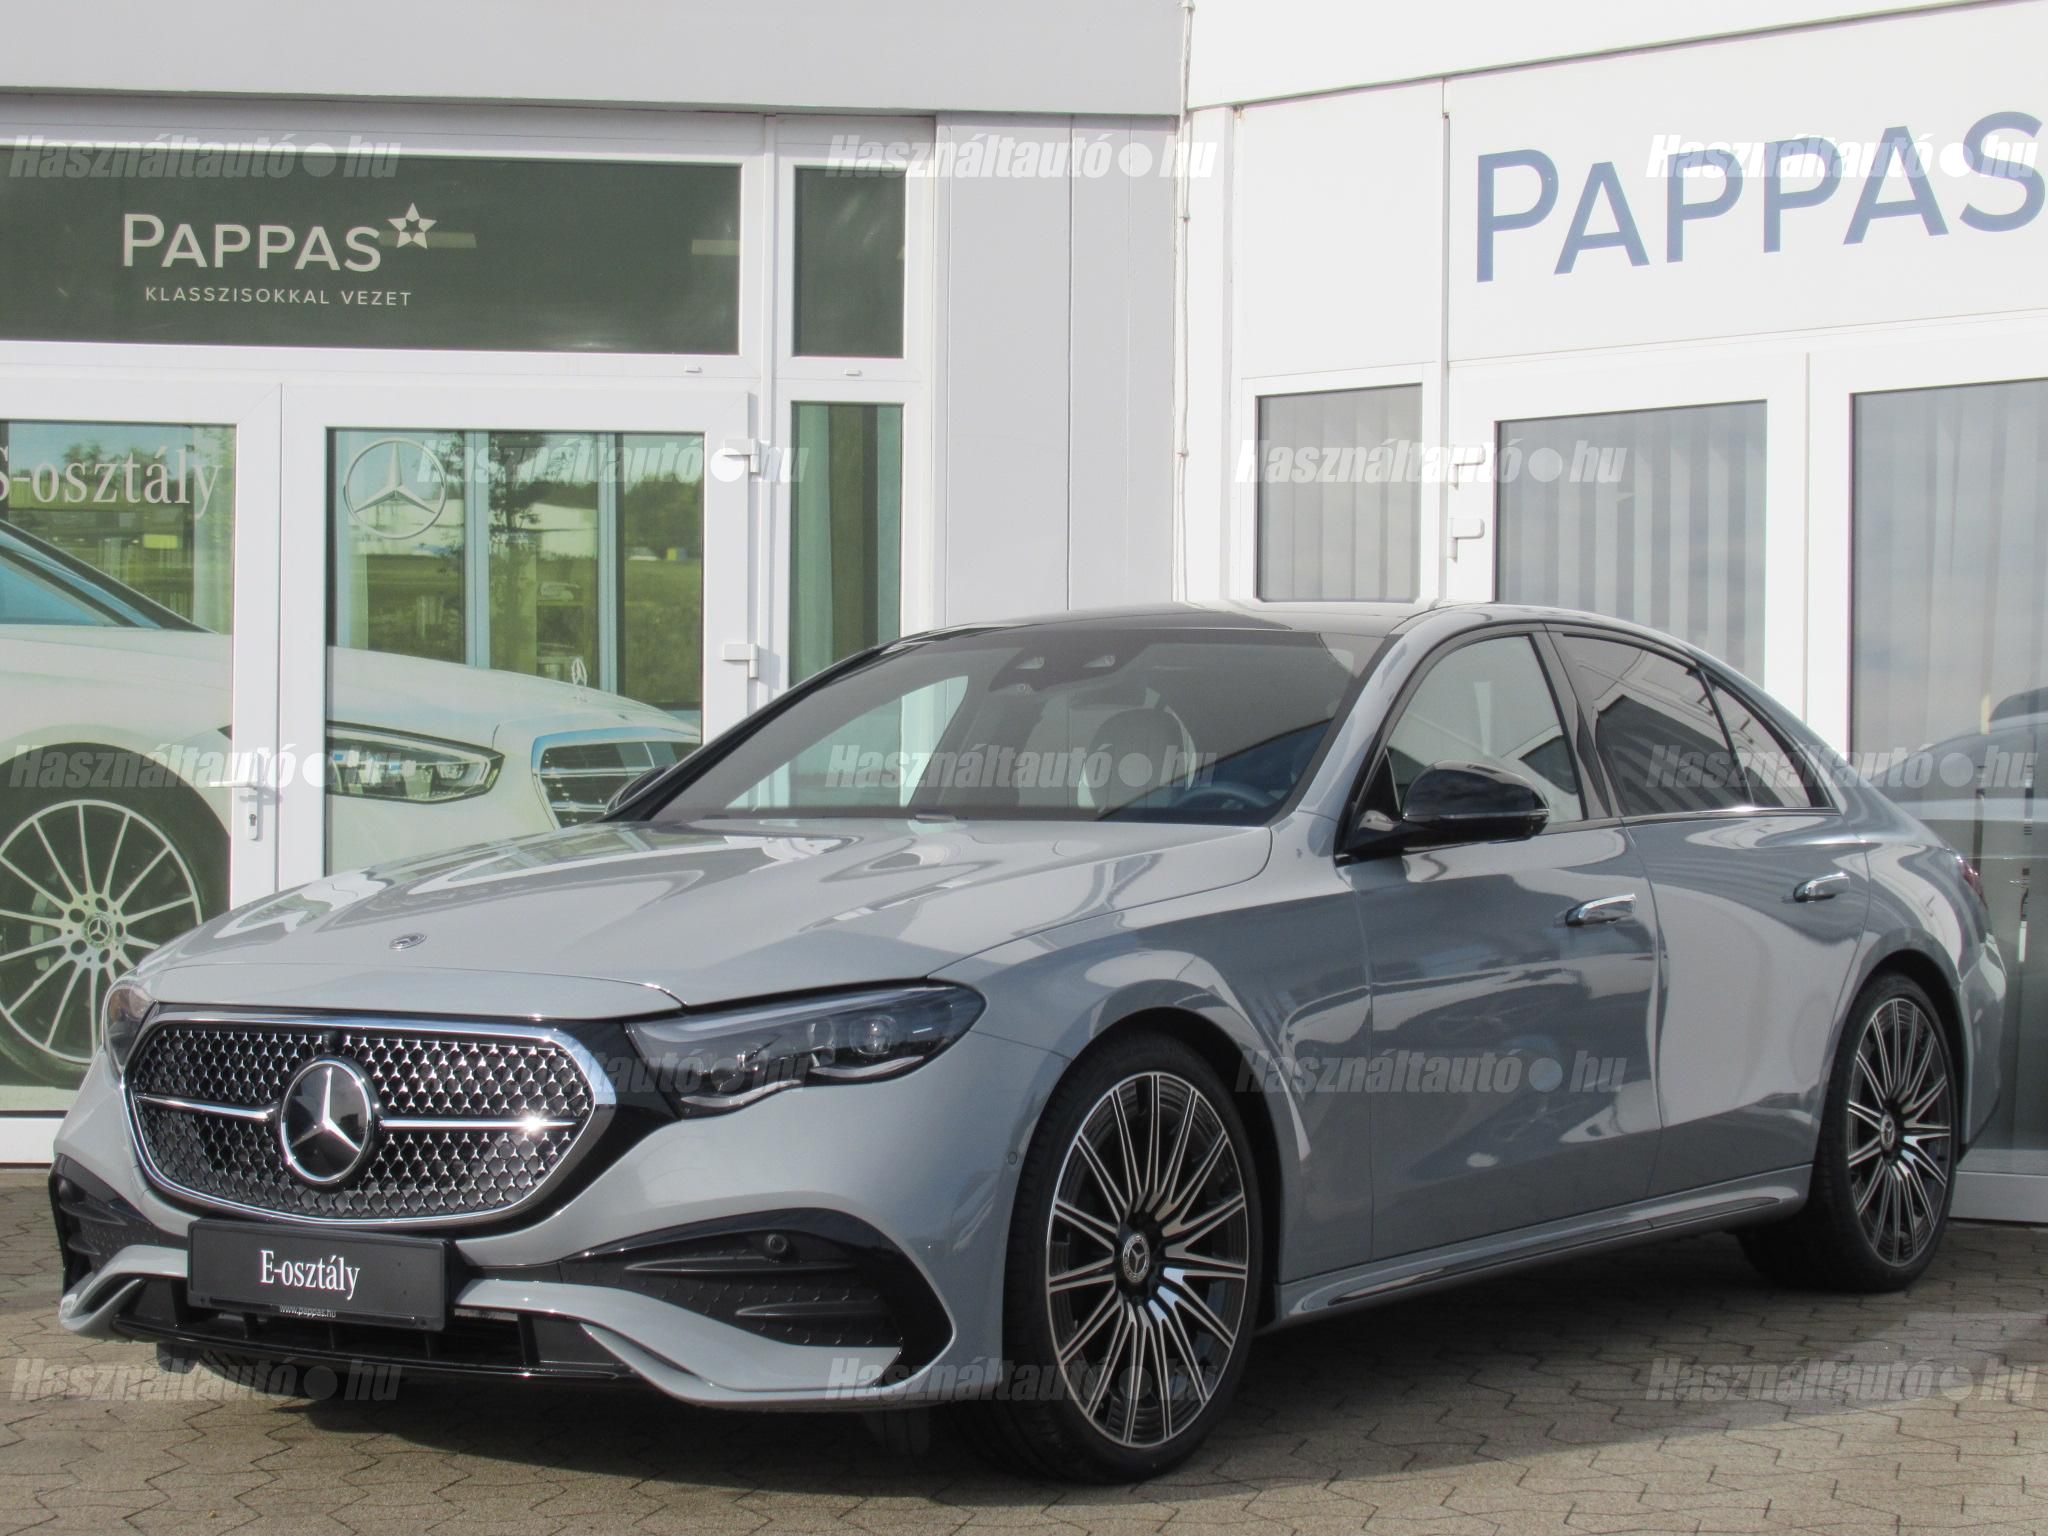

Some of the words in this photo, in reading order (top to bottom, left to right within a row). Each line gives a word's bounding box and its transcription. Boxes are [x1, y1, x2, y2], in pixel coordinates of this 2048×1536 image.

[1477, 111, 2045, 282] PAPPAS
[123, 213, 382, 272] PAPPAS
[145, 287, 330, 304] KLASSZISOKKAL
[341, 290, 412, 306] VEZET
[260, 1249, 361, 1301] E-osztály
